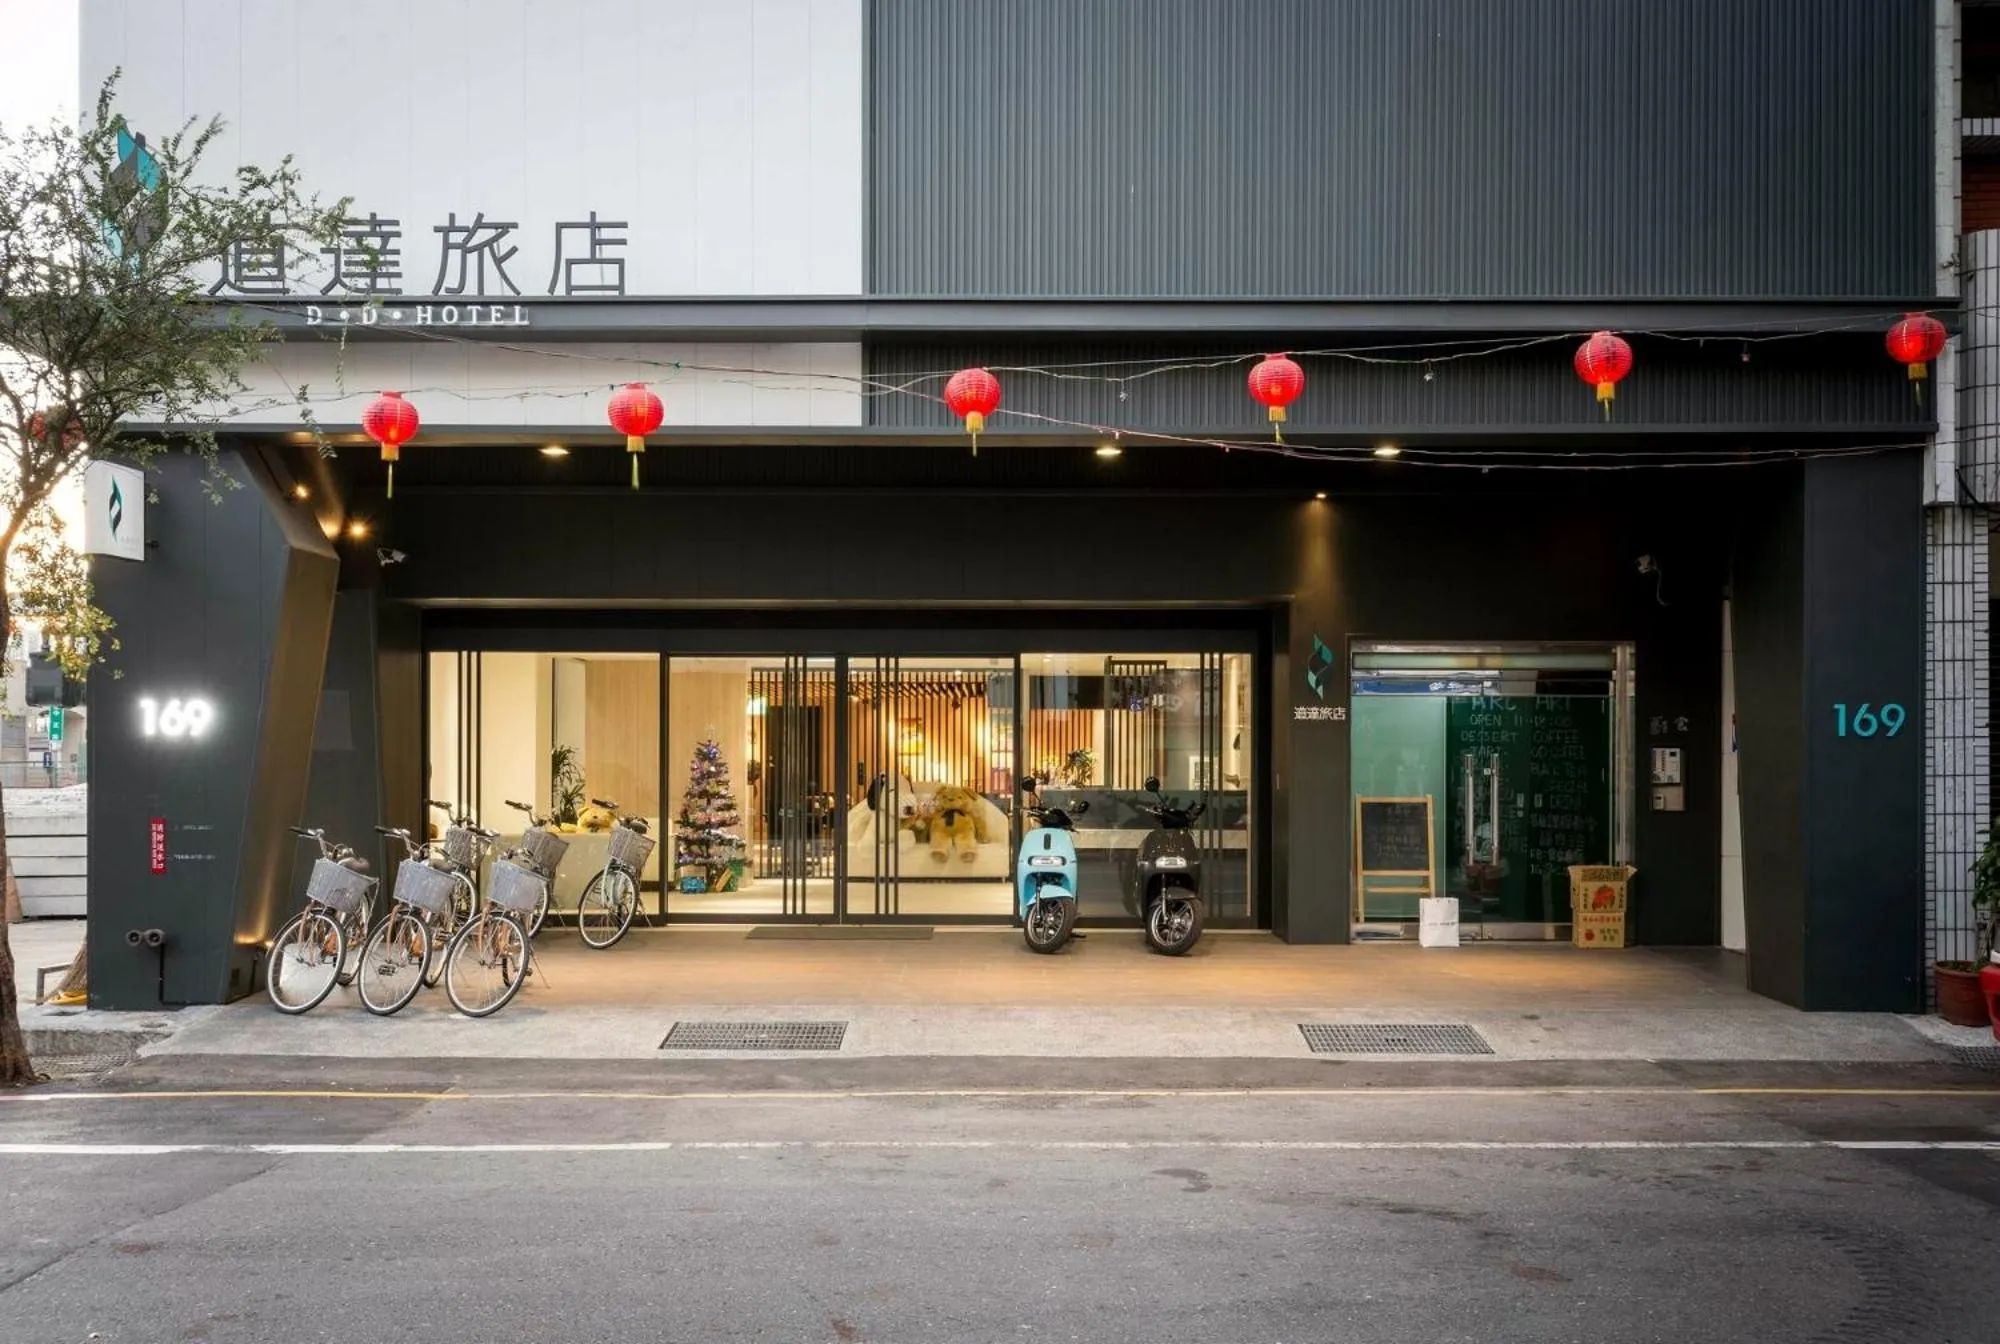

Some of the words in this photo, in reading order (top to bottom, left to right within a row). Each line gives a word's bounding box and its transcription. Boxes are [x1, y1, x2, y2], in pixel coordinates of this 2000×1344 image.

[139, 697, 212, 736] 169
[1293, 705, 1346, 721] 道達旅店
[1833, 703, 1905, 737] 169
